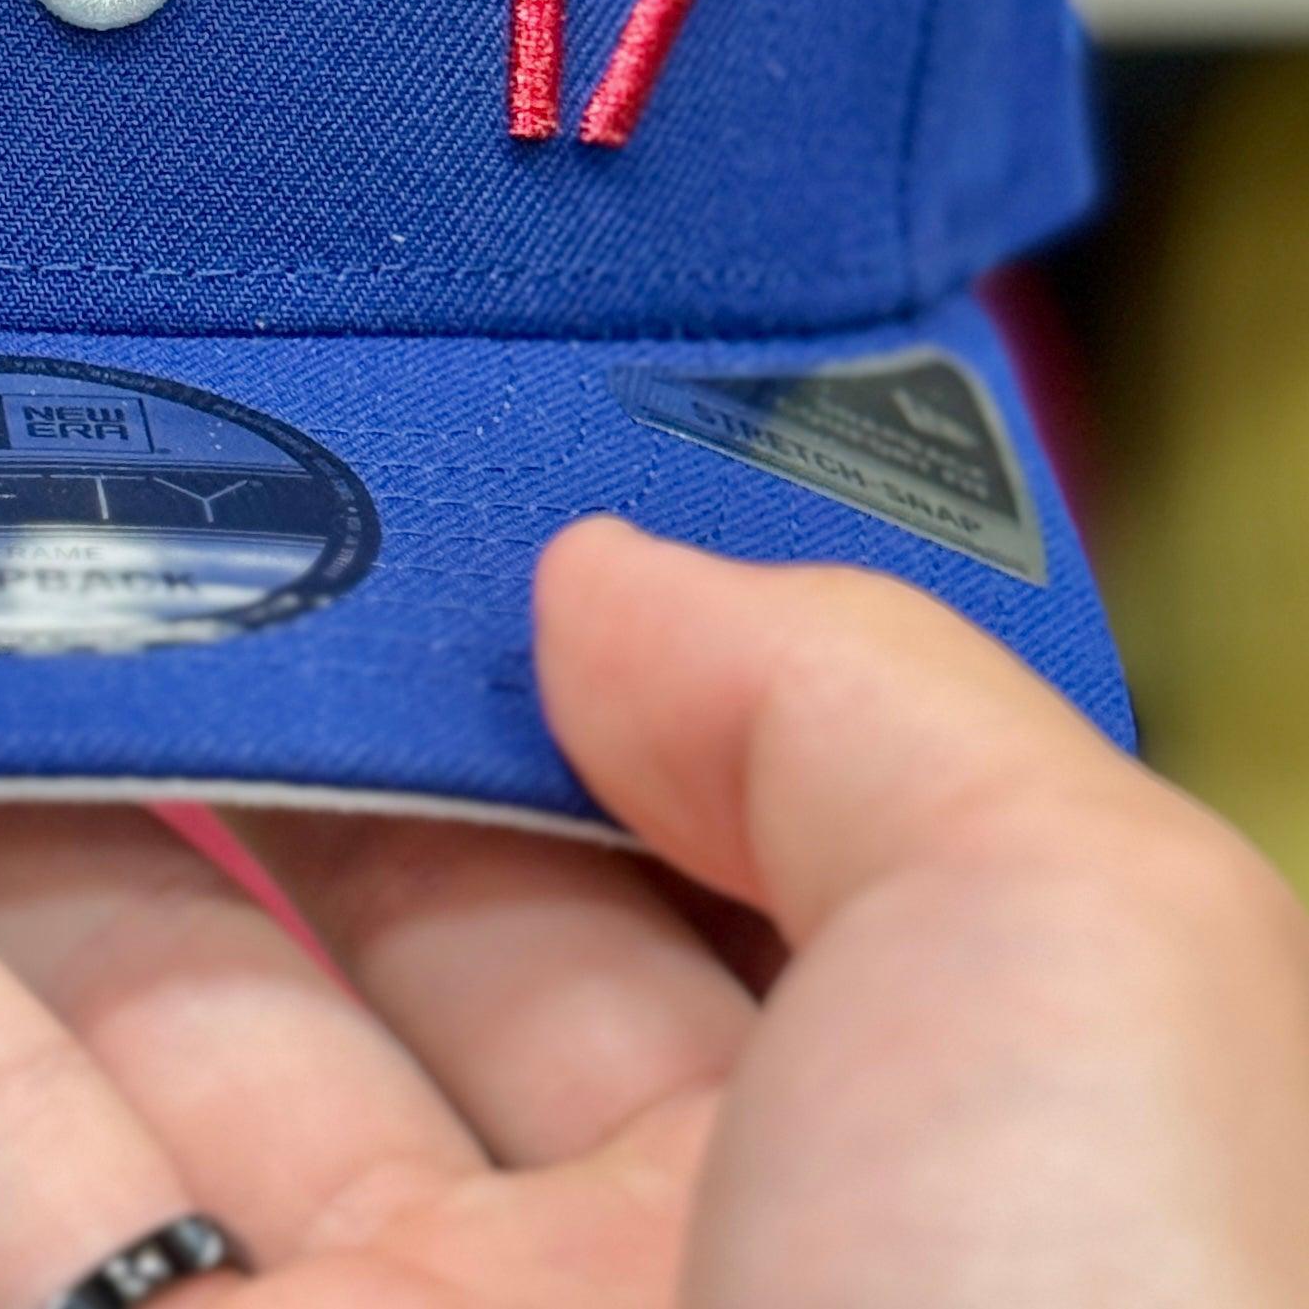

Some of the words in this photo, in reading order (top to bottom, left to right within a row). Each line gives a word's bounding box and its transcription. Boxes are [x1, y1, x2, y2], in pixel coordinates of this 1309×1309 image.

[22, 405, 127, 422] NEW
[26, 422, 130, 441] ERA
[690, 400, 867, 488] STRETCH
